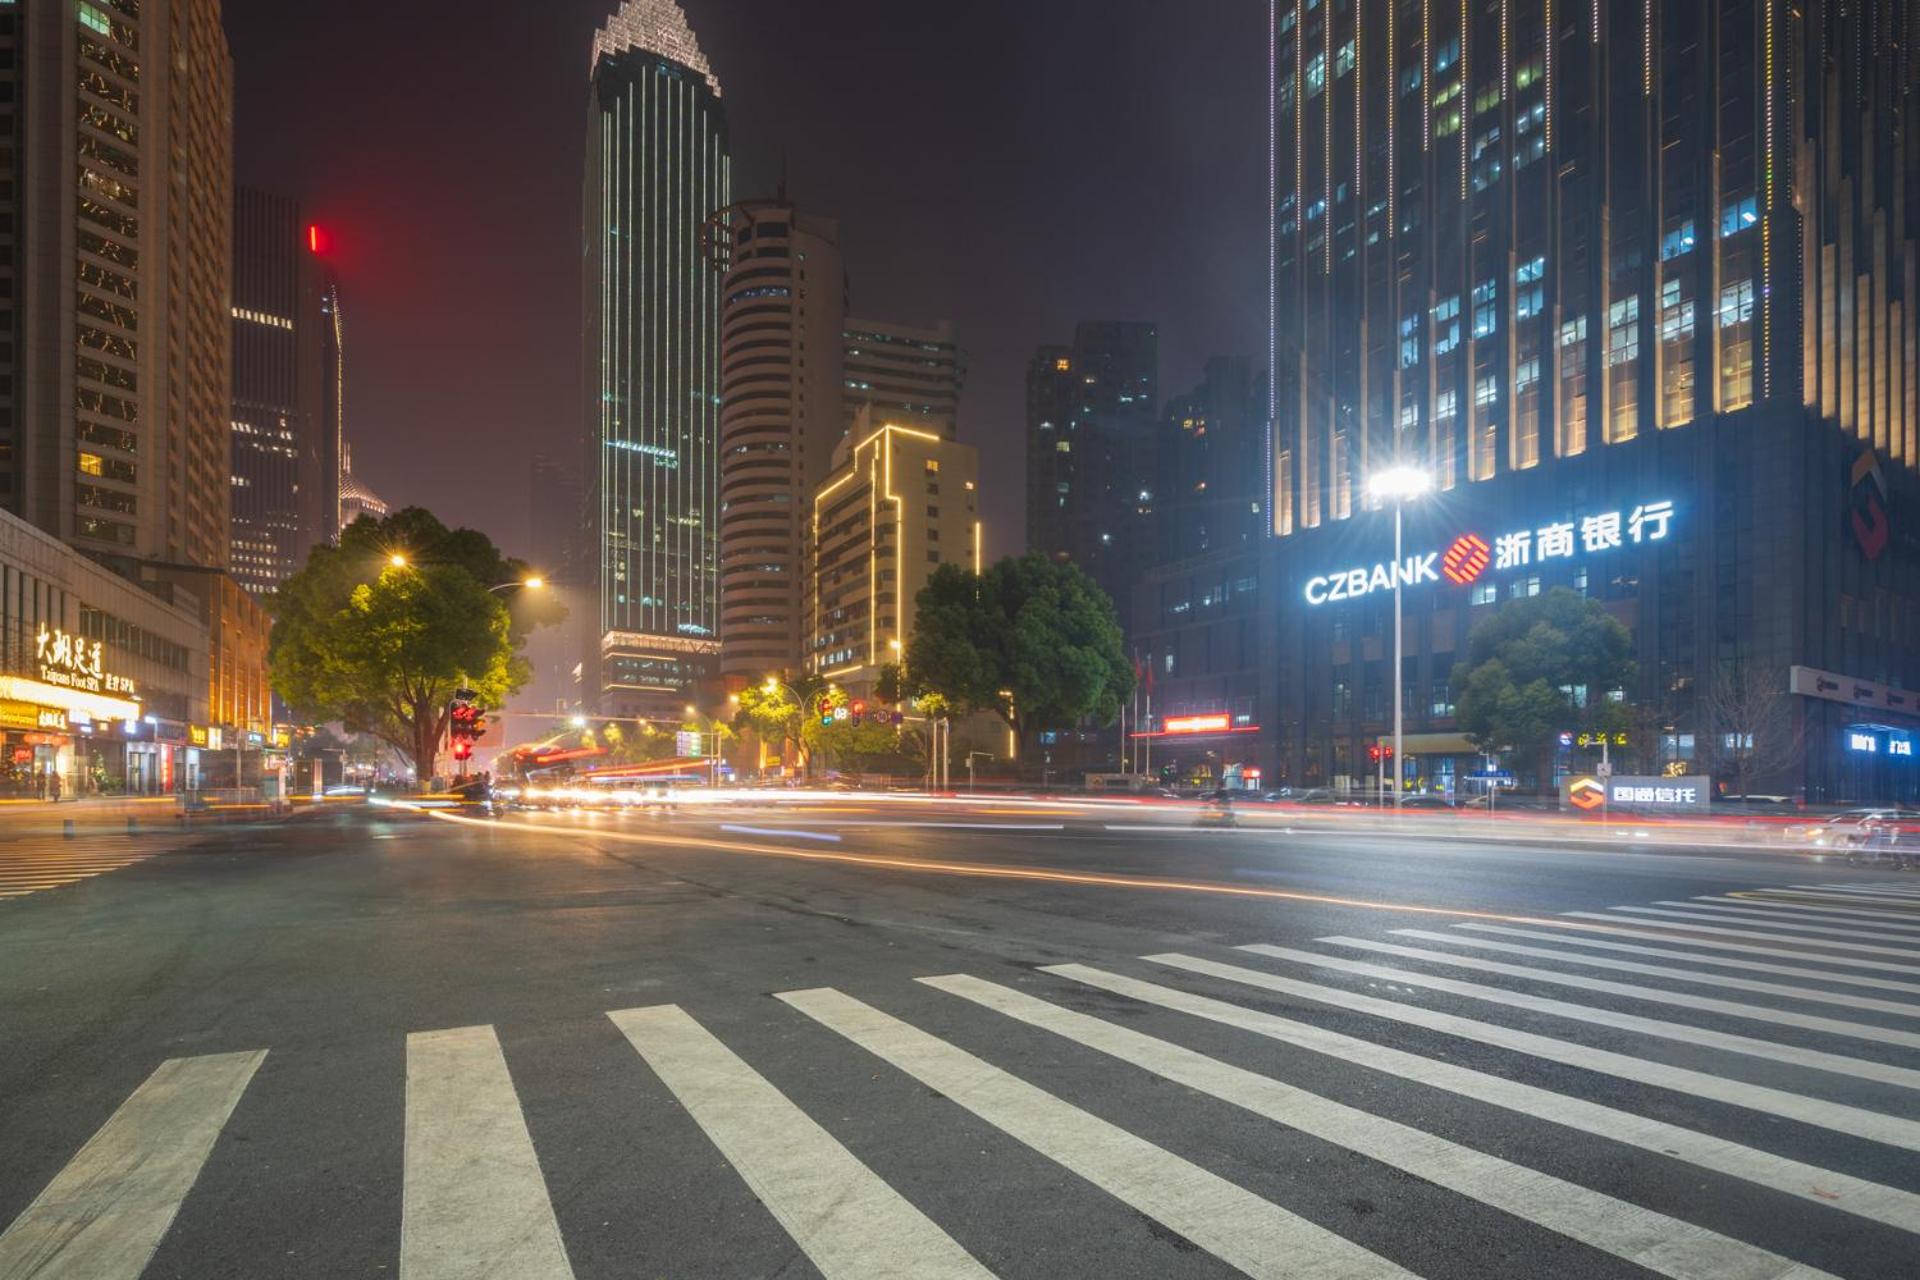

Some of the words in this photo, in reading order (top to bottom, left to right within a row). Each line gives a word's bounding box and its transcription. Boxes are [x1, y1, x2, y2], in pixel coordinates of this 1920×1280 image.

[1495, 500, 1675, 570] 浙商银行
[1304, 551, 1439, 606] CZBANK
[71, 672, 87, 690] Foot
[87, 676, 100, 692] SPA
[120, 677, 135, 694] SPA
